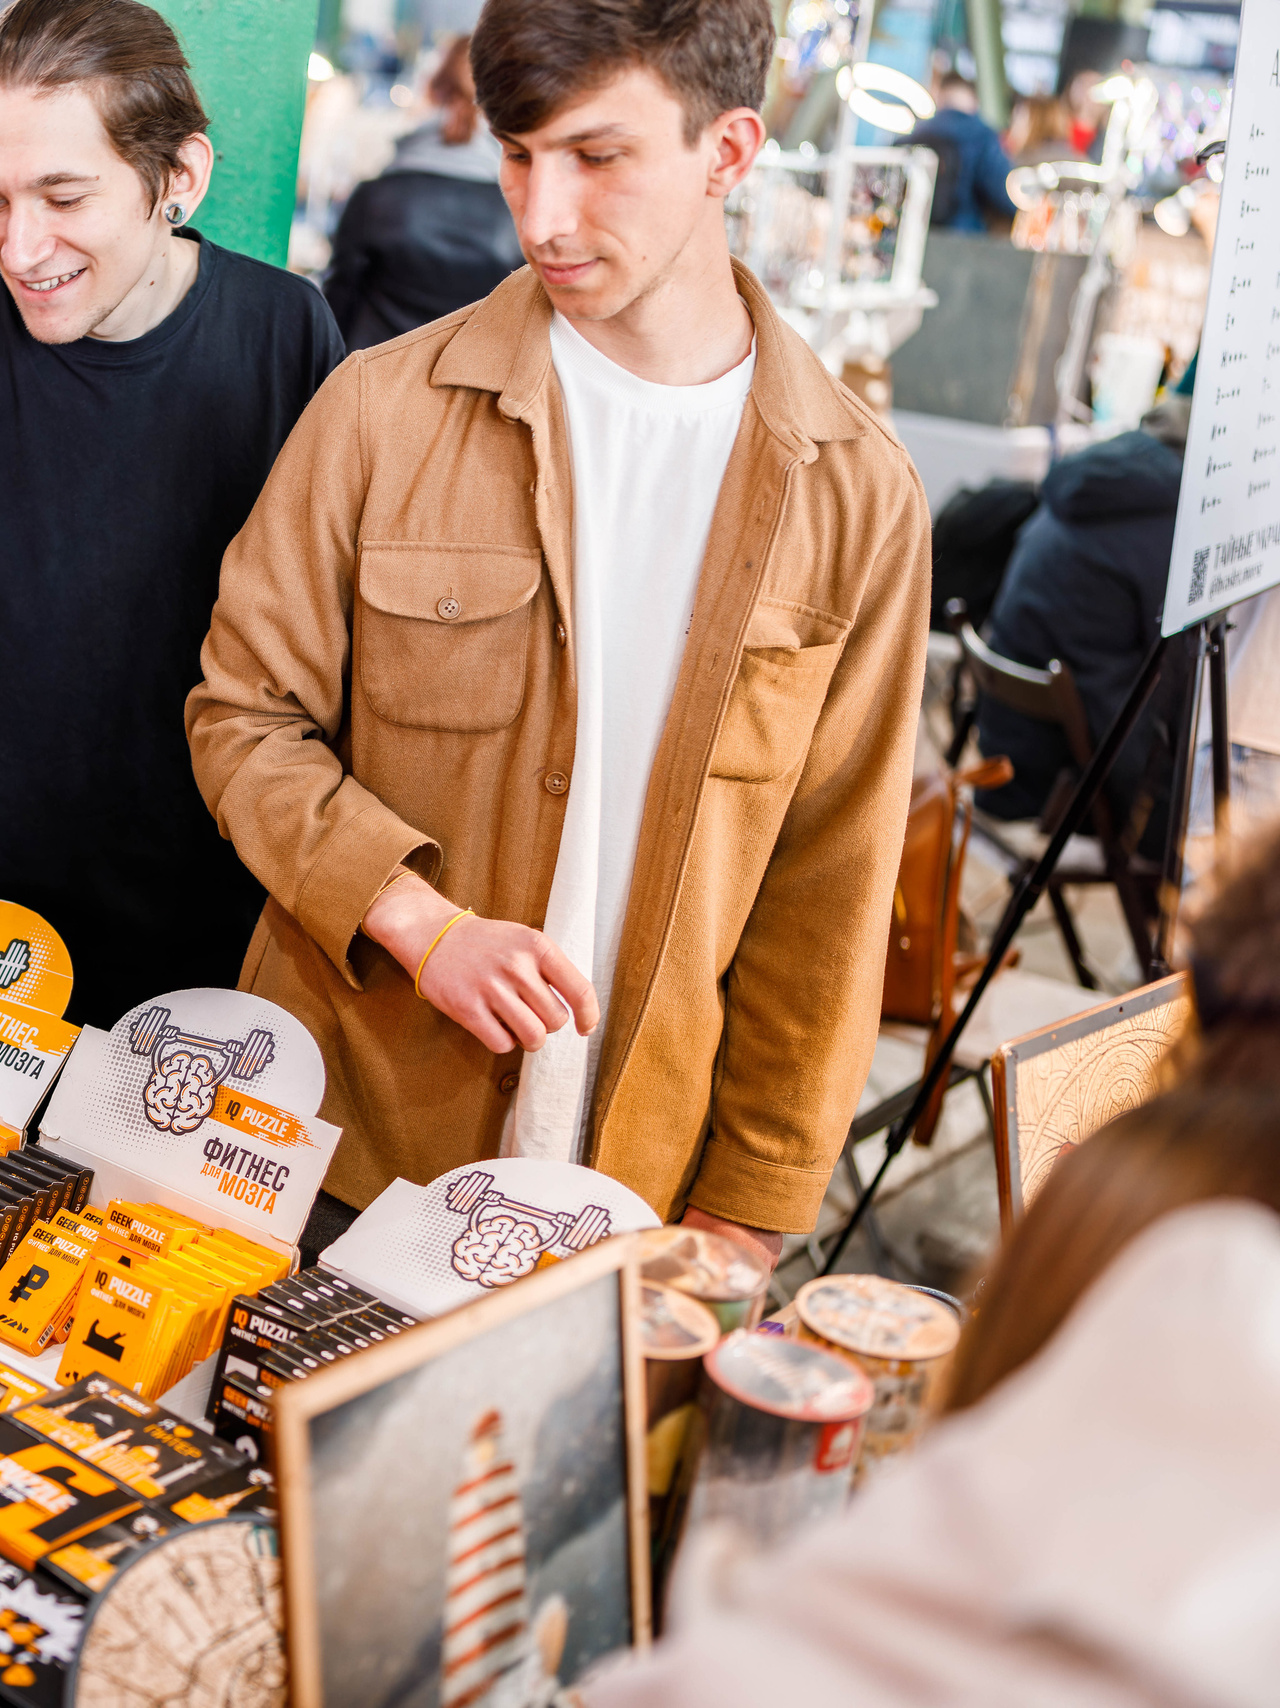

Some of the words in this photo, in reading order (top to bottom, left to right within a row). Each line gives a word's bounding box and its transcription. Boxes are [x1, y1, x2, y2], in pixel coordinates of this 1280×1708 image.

[225, 1100, 241, 1121] IQ
[240, 1106, 290, 1138] PUZZLE
[203, 1137, 290, 1192] ФИТНЕС
[200, 1162, 222, 1180] ДЛЯ
[217, 1171, 277, 1215] МОЗГА
[32, 1228, 88, 1259] GEEKPUZZLE
[106, 1223, 129, 1238] ФИТНЕС
[128, 1233, 142, 1244] ДЛЯ
[142, 1239, 161, 1253] МОЗГА
[110, 1210, 165, 1244] GEEKPUZZLE
[27, 1238, 50, 1253] ФИТНЕС
[48, 1246, 62, 1258] ДЛЯ
[61, 1253, 80, 1266] МОЗГА
[95, 1270, 108, 1289] IQ
[108, 1276, 152, 1309] PUZZLE
[233, 1308, 249, 1330] IQ
